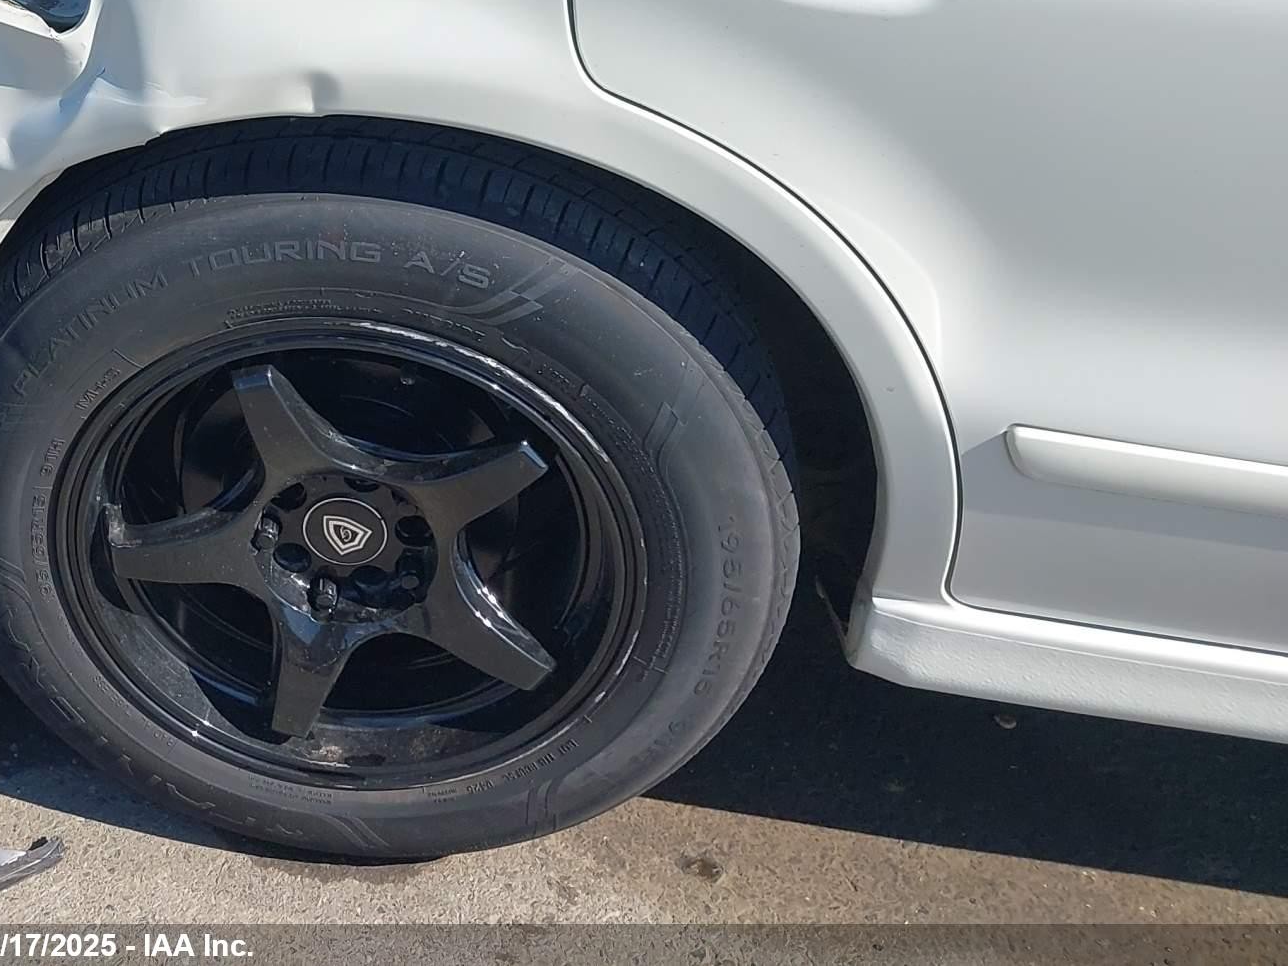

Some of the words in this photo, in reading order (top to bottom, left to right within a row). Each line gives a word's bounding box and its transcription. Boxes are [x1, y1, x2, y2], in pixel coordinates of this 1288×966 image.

[11, 270, 168, 396] PLATINUM
[182, 240, 382, 277] TOURING
[404, 250, 491, 289] A/S
